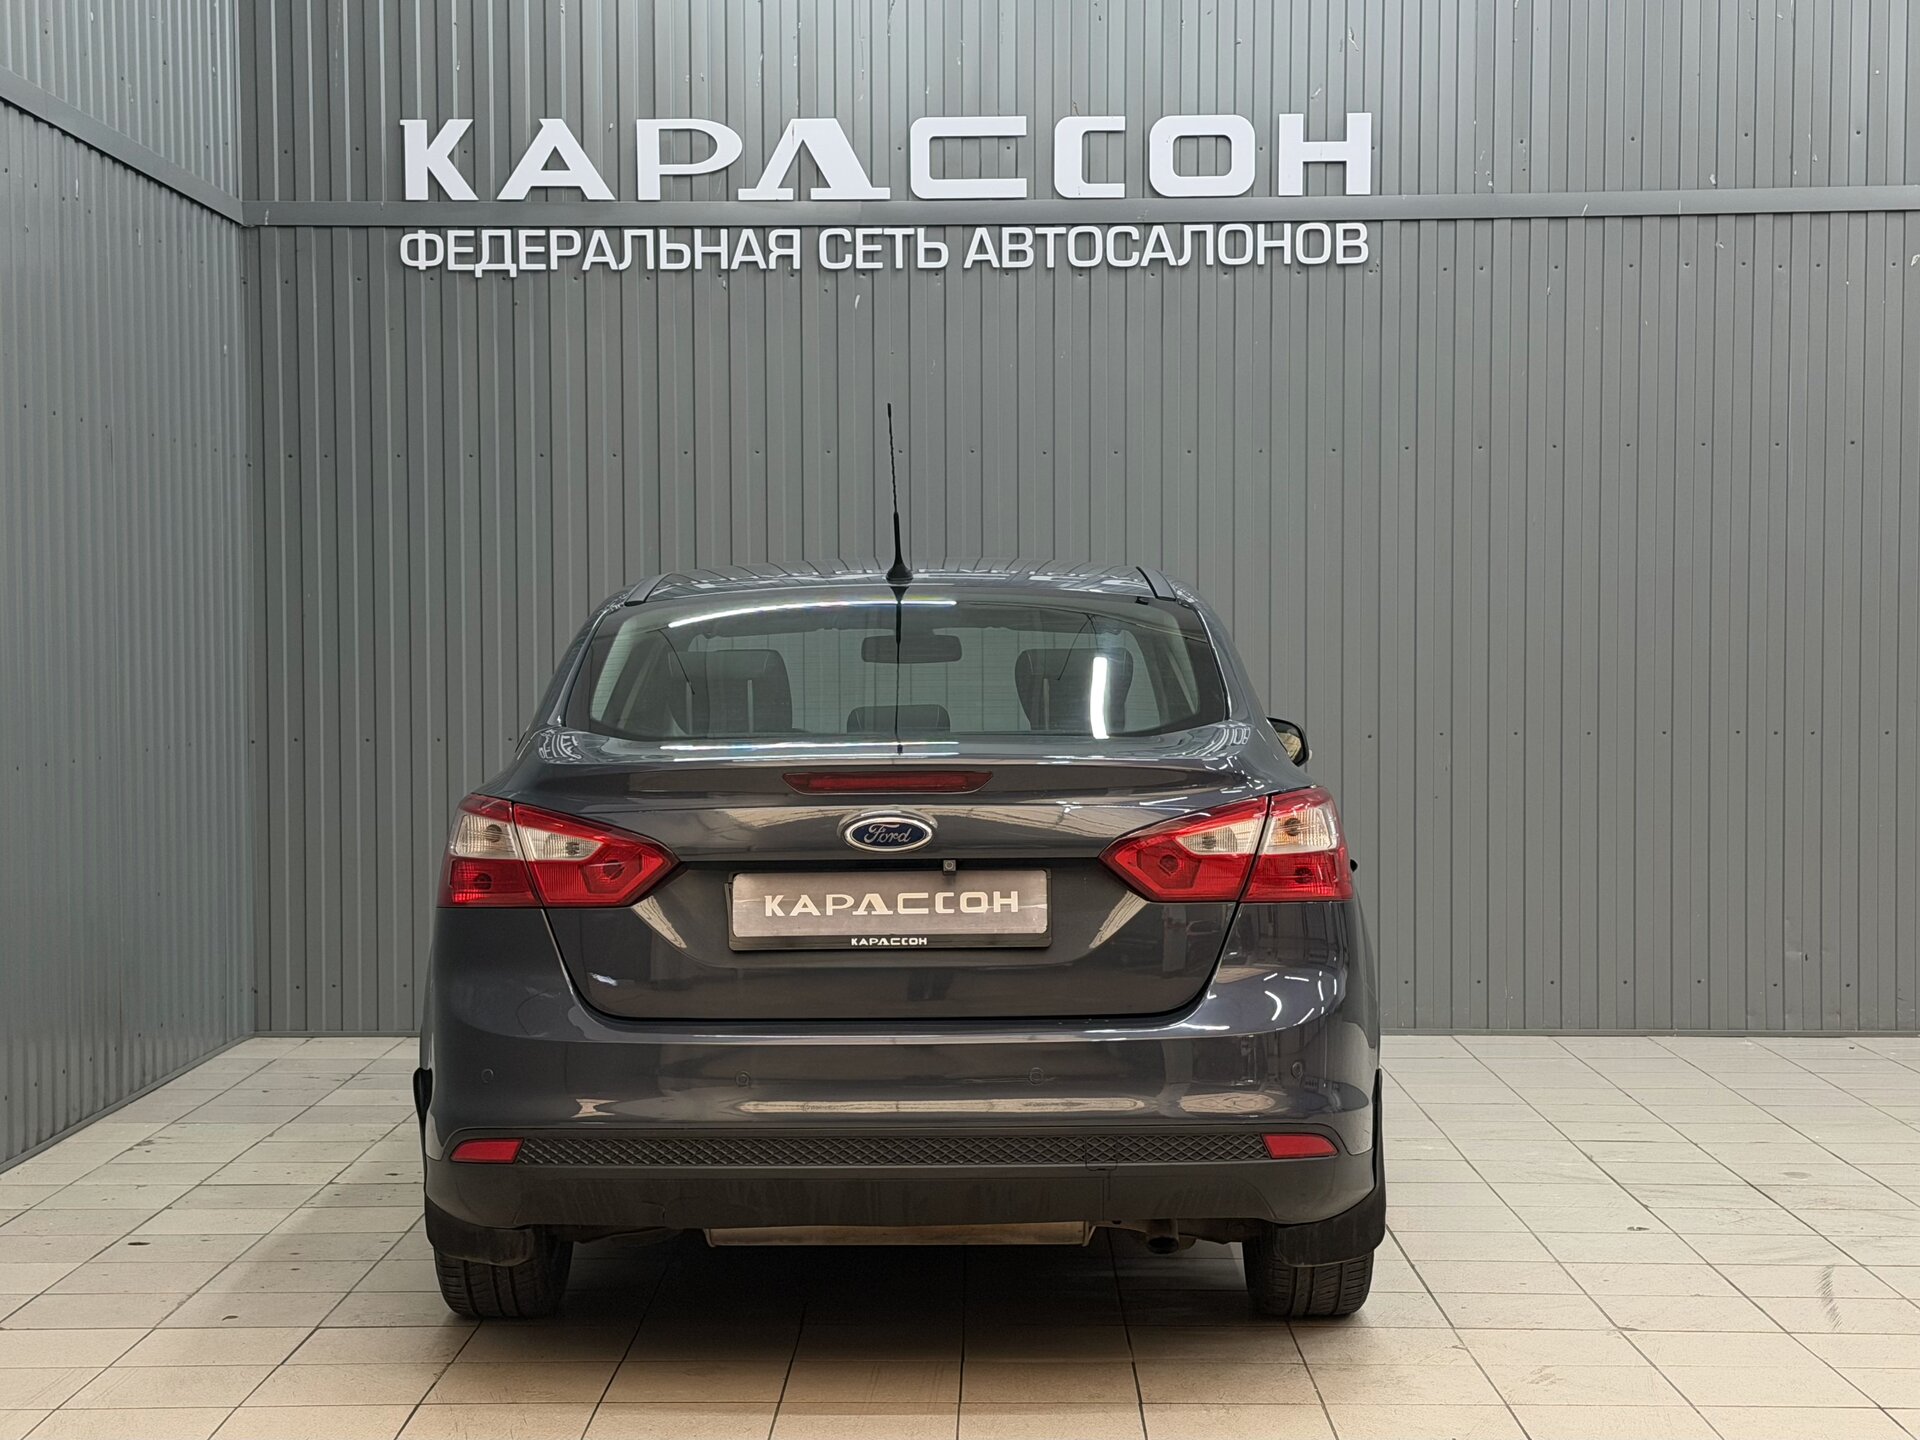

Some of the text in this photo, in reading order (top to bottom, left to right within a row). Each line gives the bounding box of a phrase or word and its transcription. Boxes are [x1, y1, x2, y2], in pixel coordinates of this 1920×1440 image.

[400, 222, 1369, 278] ФЕДЕРАЛЬНАЯ СЕТЬ АВТОСАЛОНОВ
[863, 824, 912, 844] Ford
